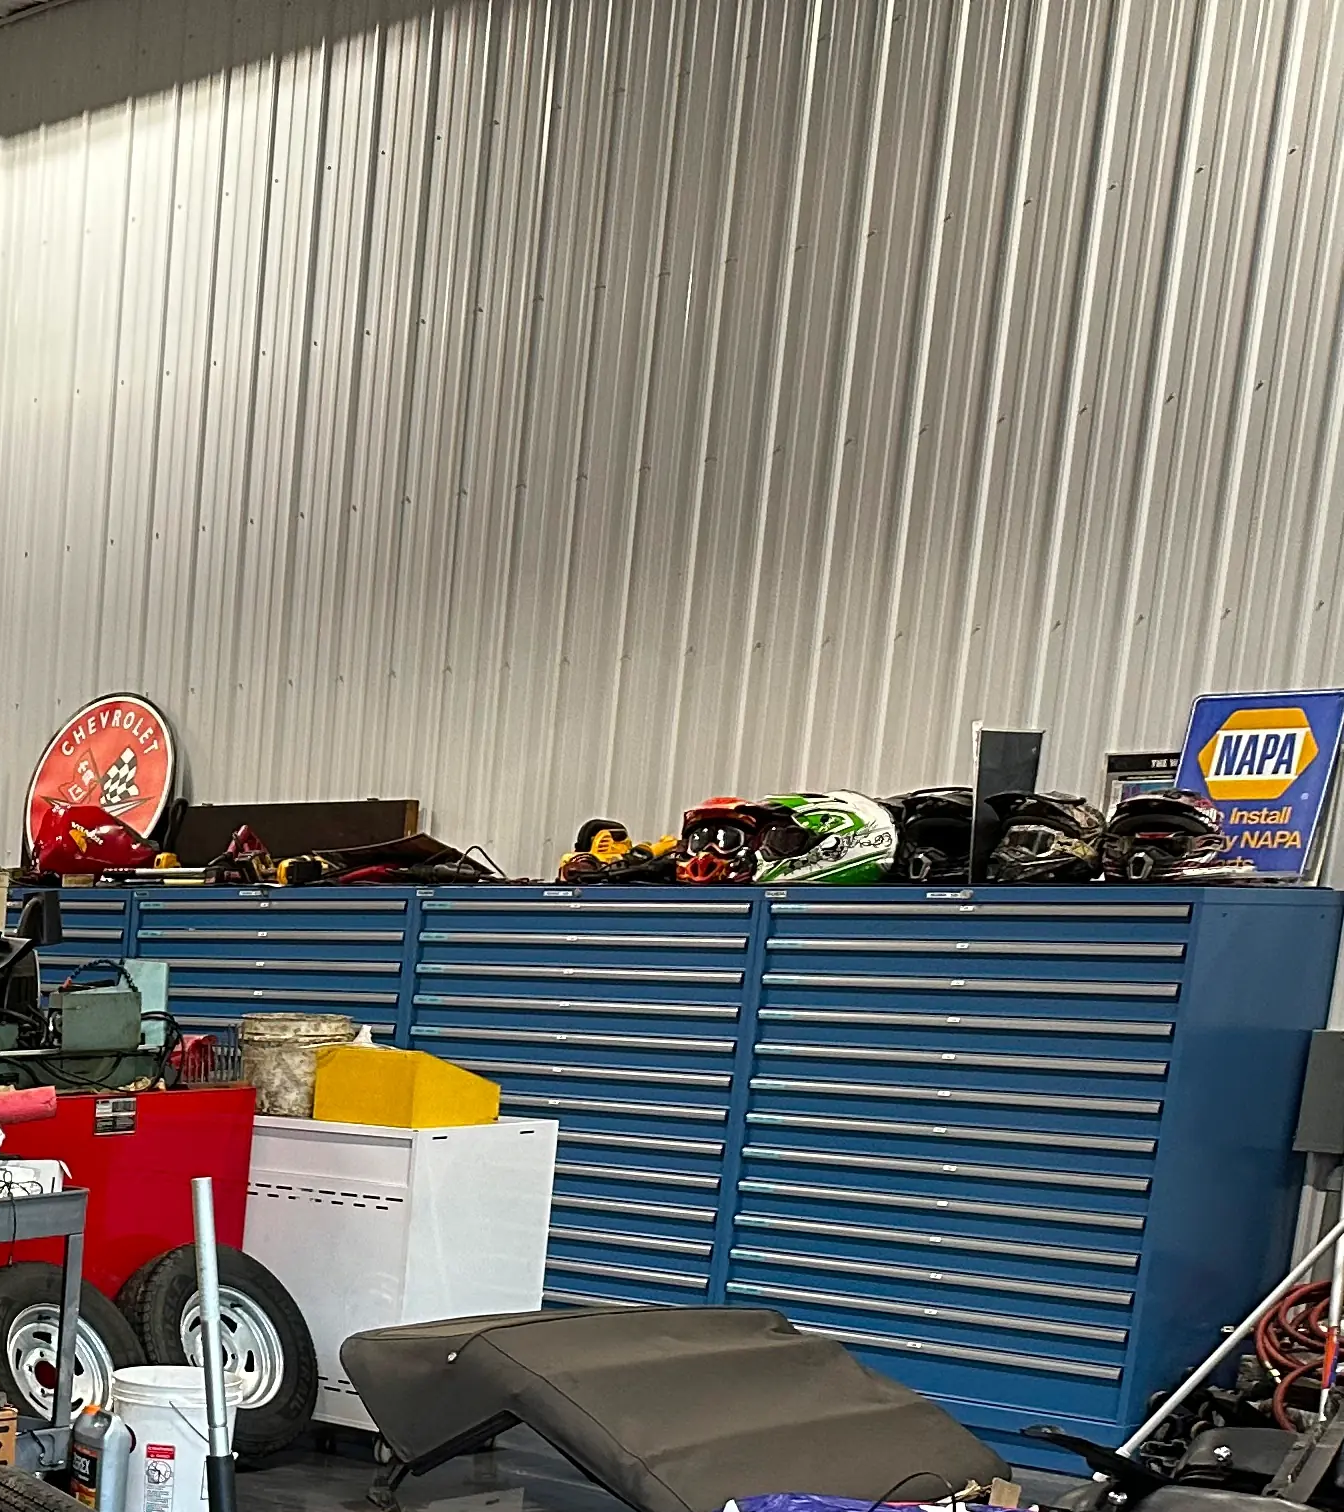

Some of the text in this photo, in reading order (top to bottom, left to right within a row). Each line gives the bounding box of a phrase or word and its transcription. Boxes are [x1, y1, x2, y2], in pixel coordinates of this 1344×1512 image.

[62, 709, 159, 756] CHEVROLET
[1214, 733, 1297, 777] NAPA
[1229, 807, 1293, 825] Install
[1240, 831, 1302, 849] NAPA
